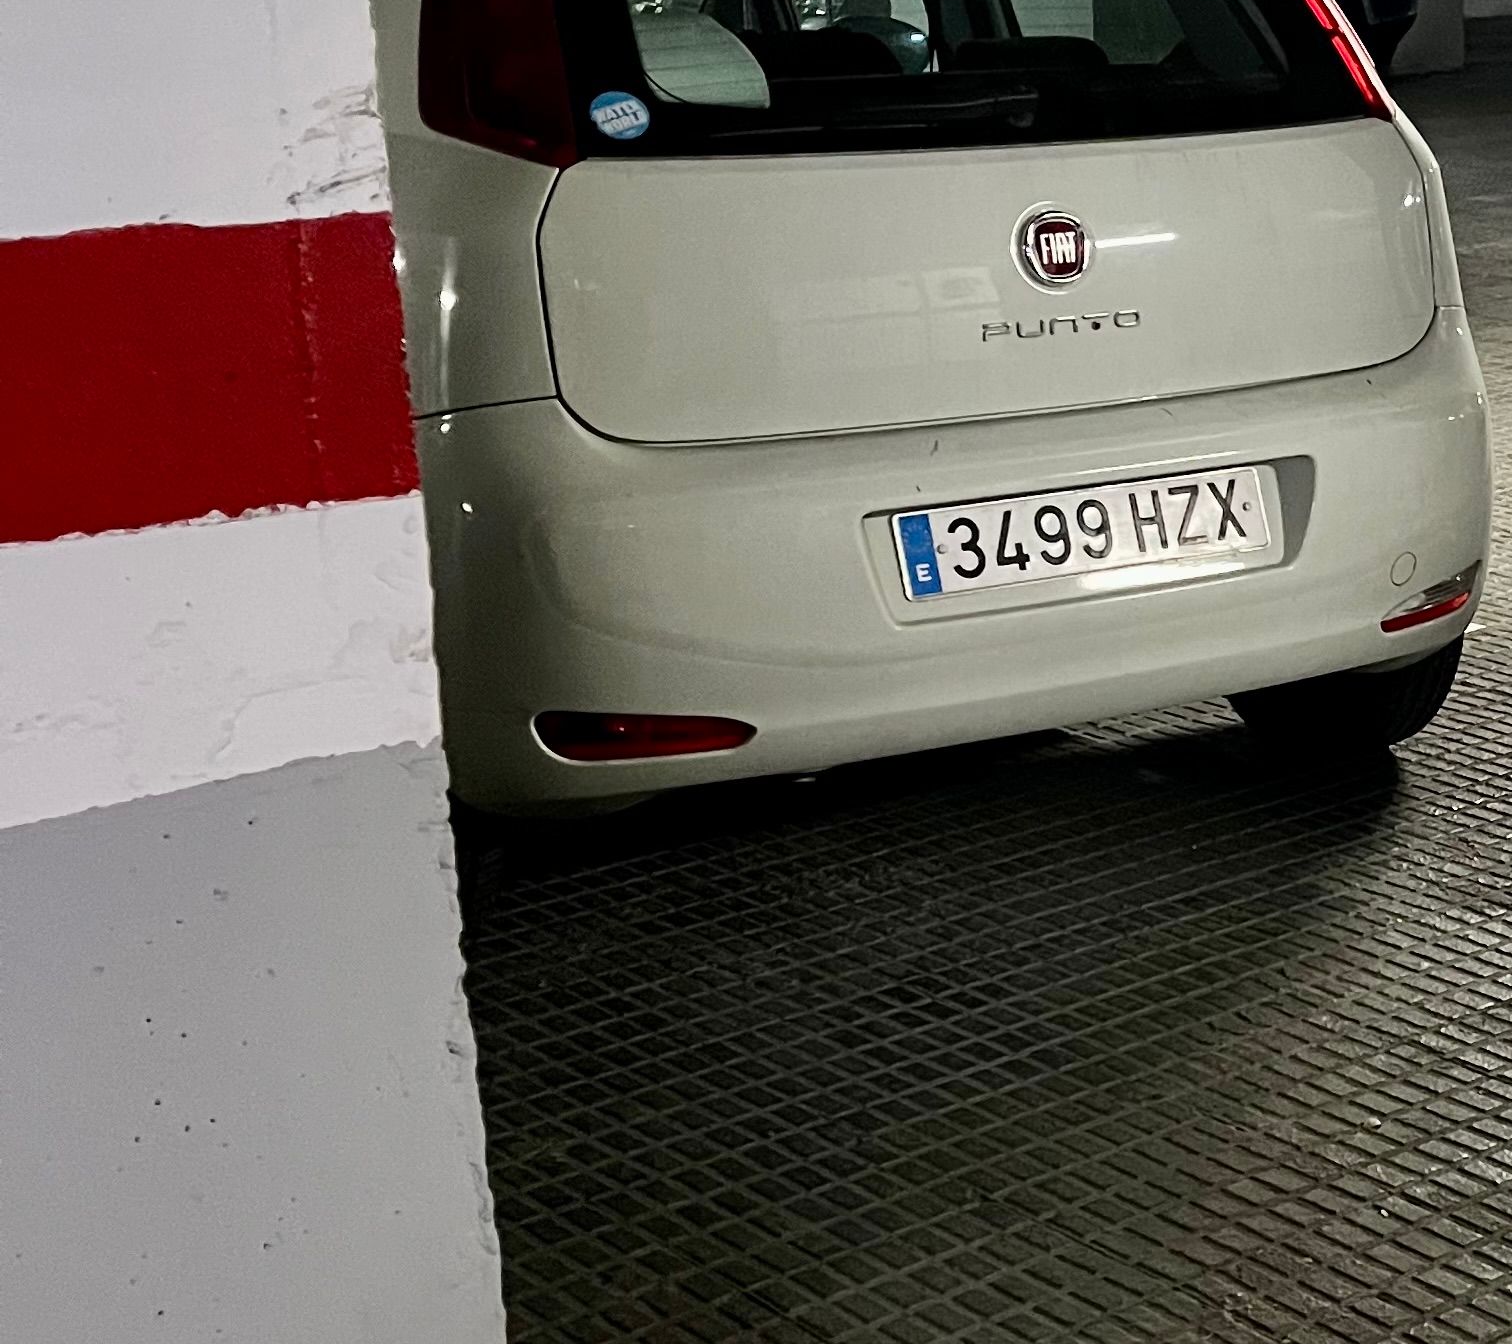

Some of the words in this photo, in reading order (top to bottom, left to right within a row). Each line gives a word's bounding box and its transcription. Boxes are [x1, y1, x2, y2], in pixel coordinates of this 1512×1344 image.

[1039, 231, 1077, 265] FIAT
[982, 309, 1140, 342] PUNTO
[947, 499, 1112, 579] 3499
[1128, 479, 1247, 553] HZX
[916, 563, 932, 582] E
